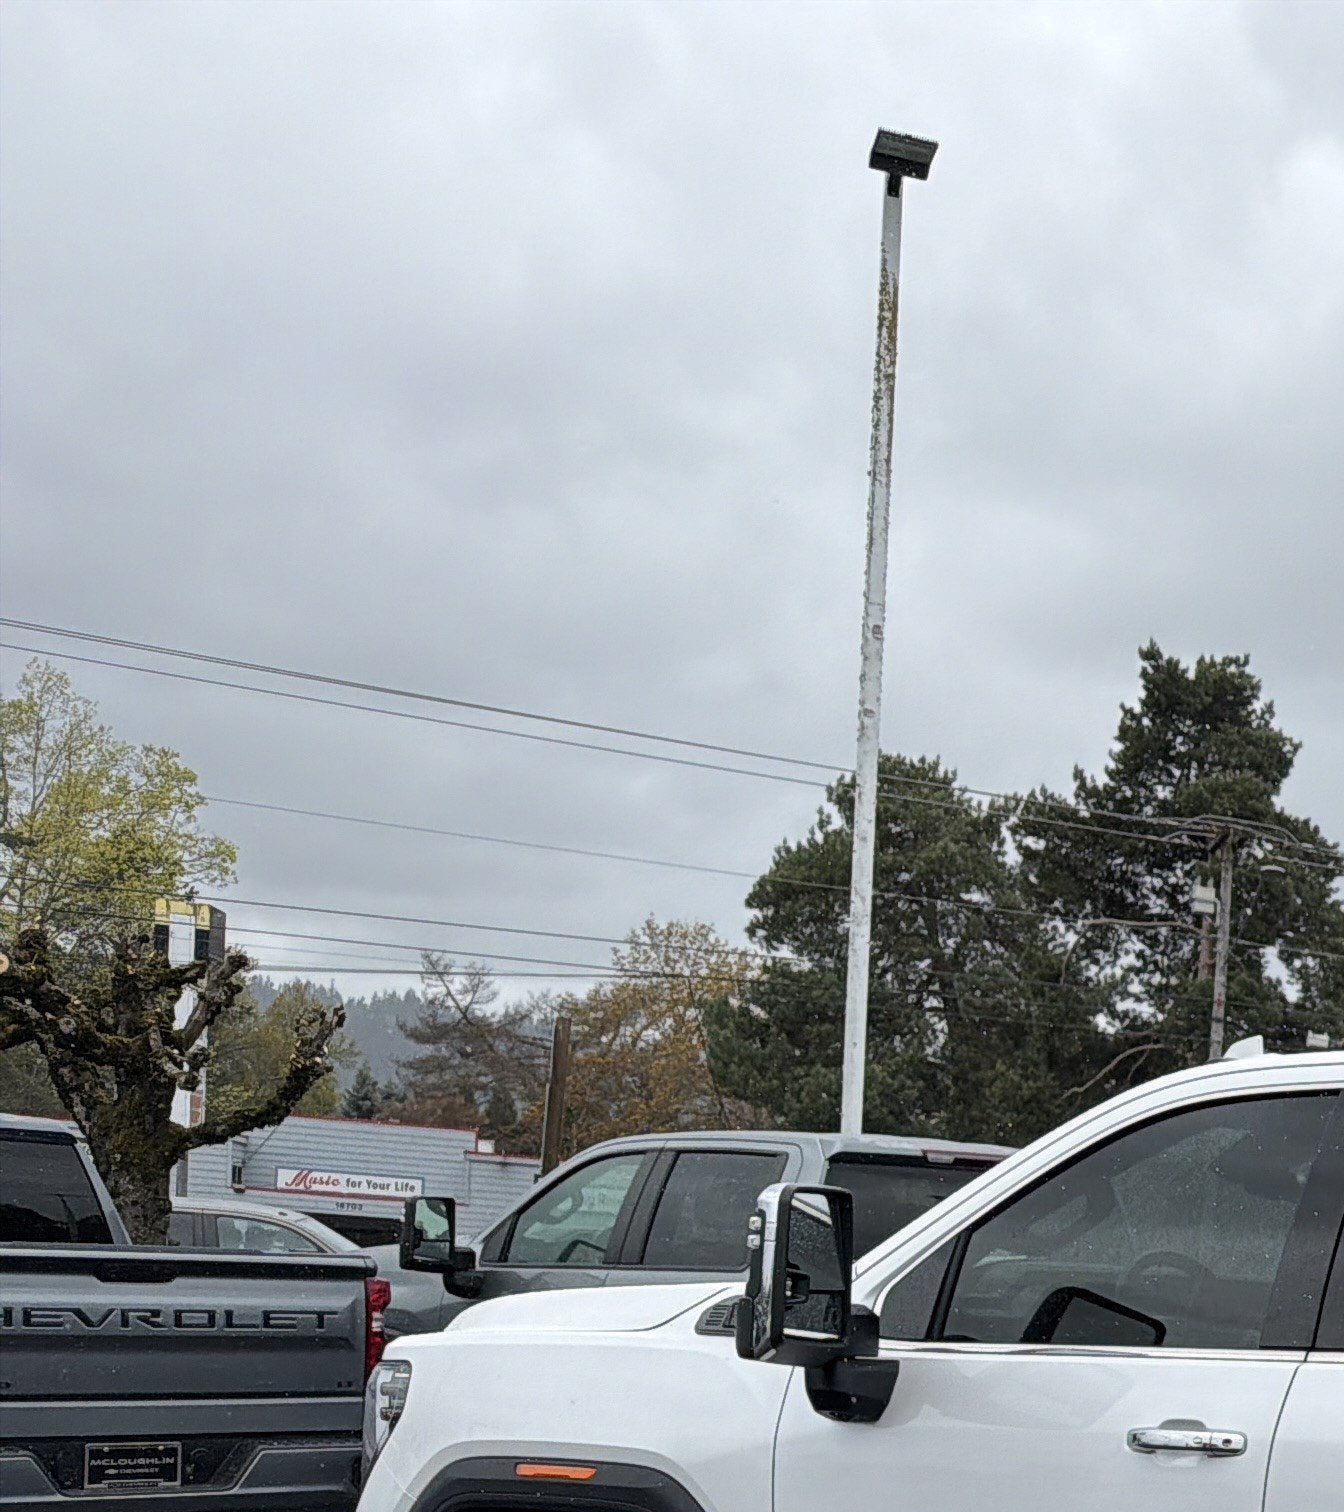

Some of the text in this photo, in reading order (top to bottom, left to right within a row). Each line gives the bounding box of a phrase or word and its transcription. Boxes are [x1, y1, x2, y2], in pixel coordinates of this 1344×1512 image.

[285, 1168, 416, 1193] Music for Your Life
[0, 1306, 340, 1332] EVROLET
[90, 1457, 175, 1466] MCLOUGHLIN
